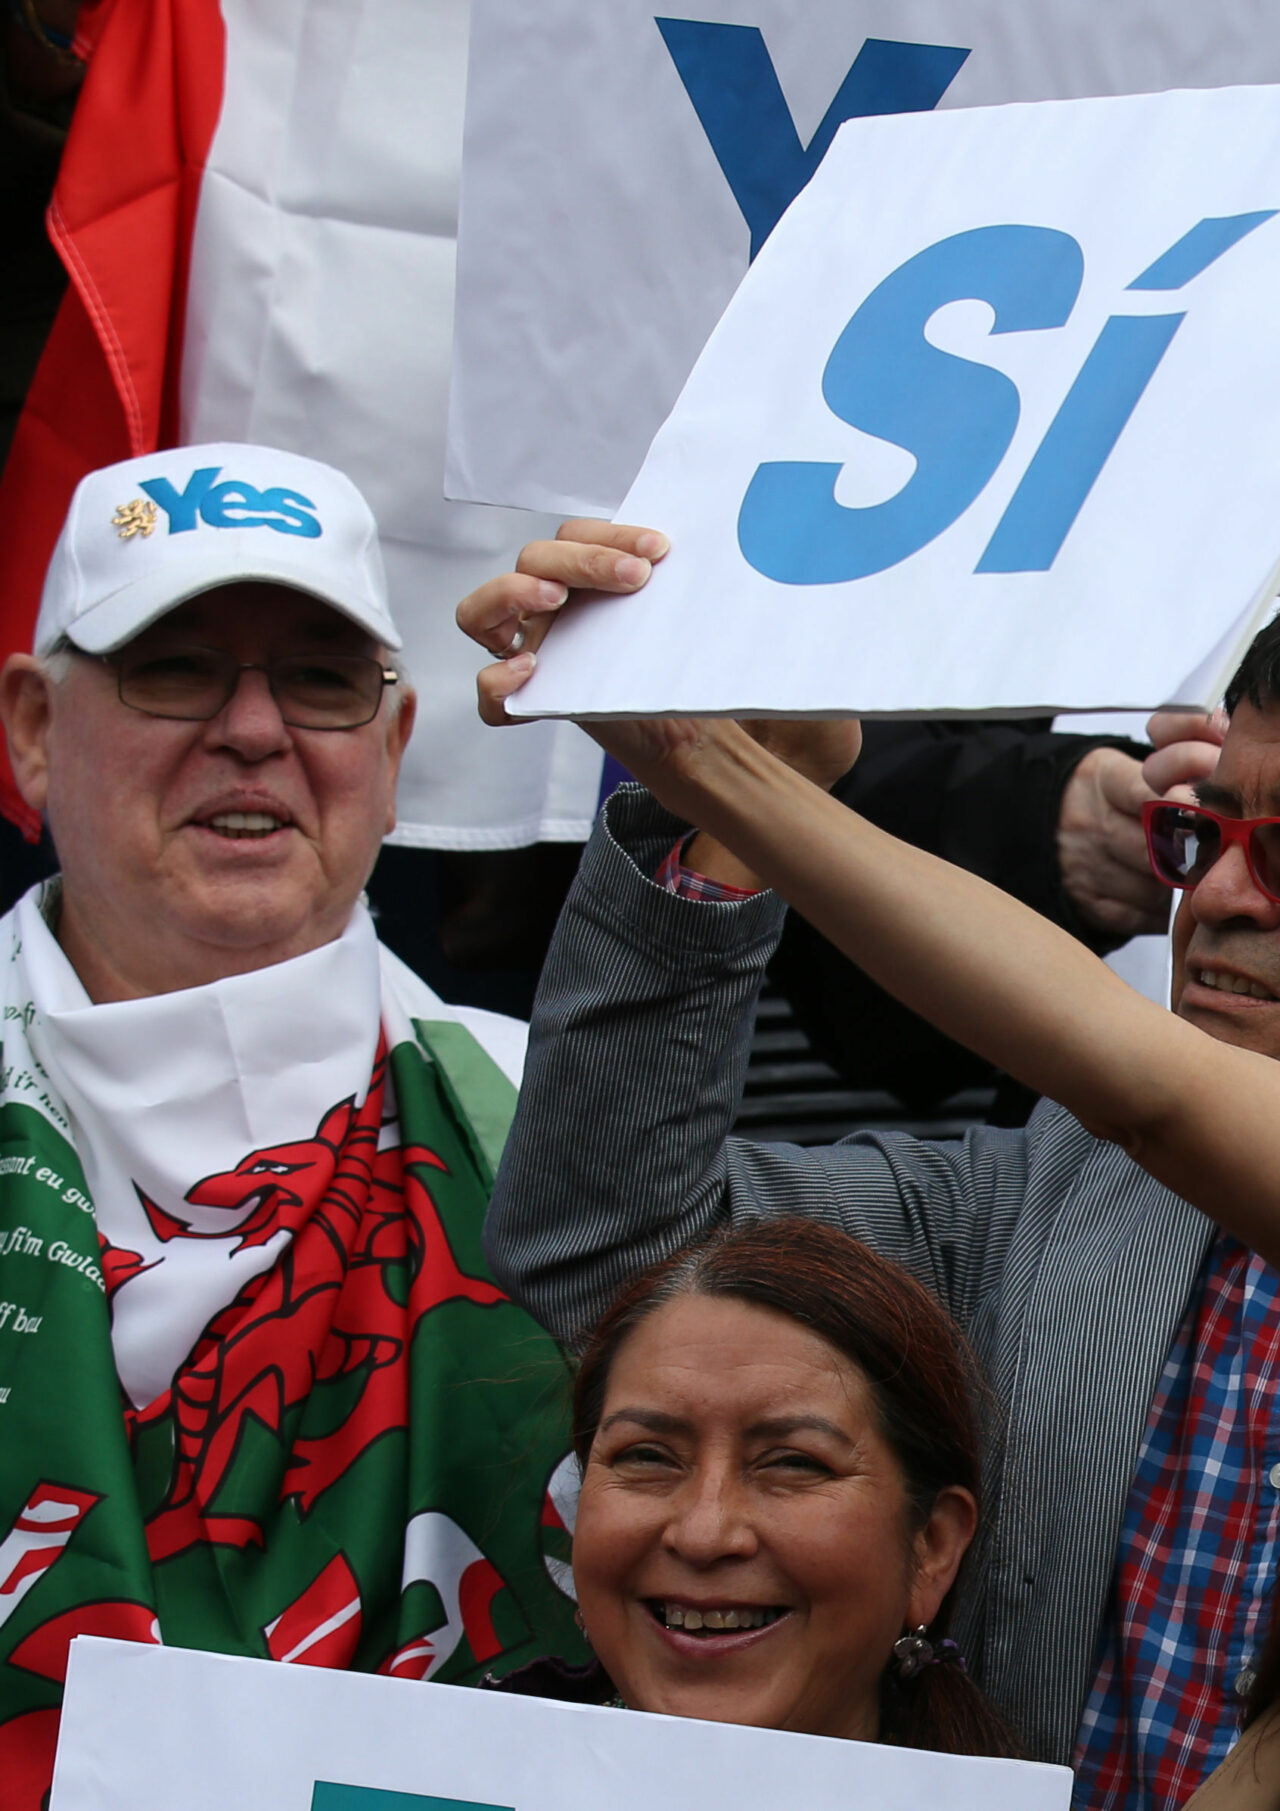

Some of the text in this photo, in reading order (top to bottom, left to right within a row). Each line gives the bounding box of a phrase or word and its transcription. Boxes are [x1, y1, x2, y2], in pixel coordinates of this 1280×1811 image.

[138, 466, 323, 539] Yes
[35, 1166, 65, 1190] eu
[61, 1187, 97, 1218] gw
